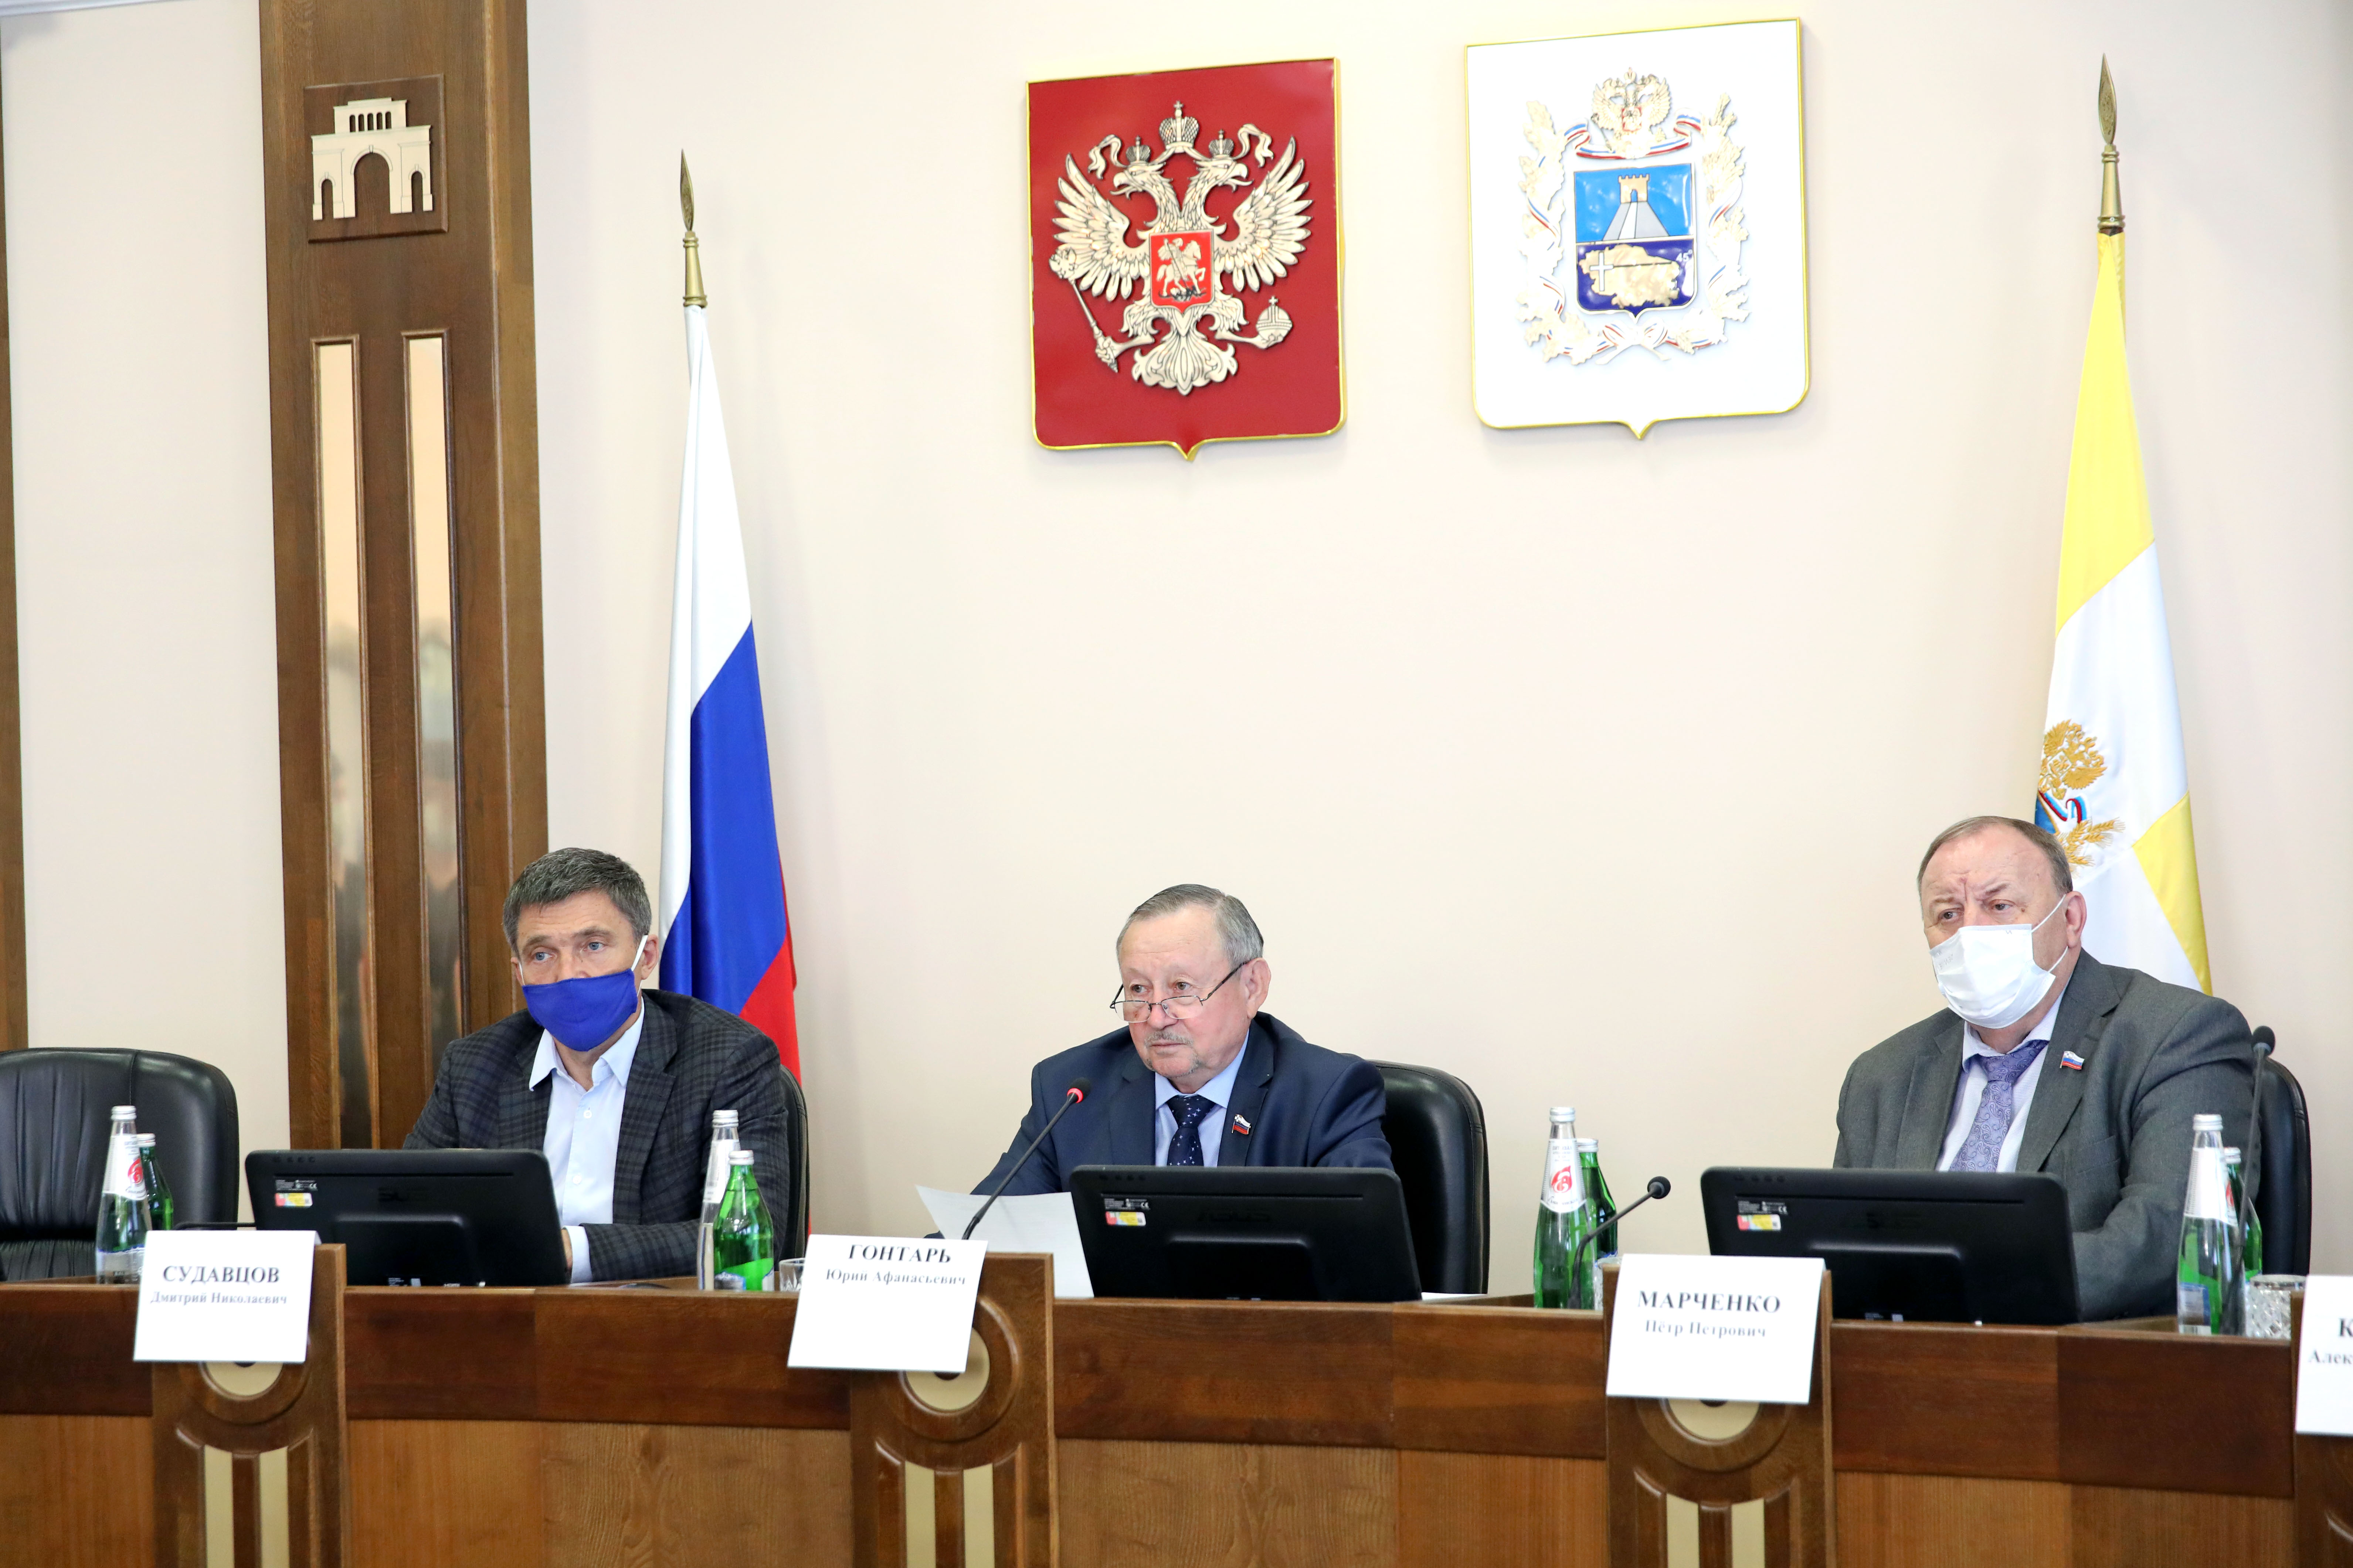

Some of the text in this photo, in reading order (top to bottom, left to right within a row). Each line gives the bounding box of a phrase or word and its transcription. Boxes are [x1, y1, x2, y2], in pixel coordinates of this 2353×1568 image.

[848, 1244, 951, 1263] ГОНТАРЬ
[162, 1265, 280, 1285] СУДАВЦОВ
[826, 1268, 965, 1285] Юрий Афанасьевич
[150, 1291, 287, 1306] Дмитрий Николаевич
[1637, 1290, 1781, 1313] МАРЧЕНКО
[1645, 1319, 1766, 1339] Пётр Петрович
